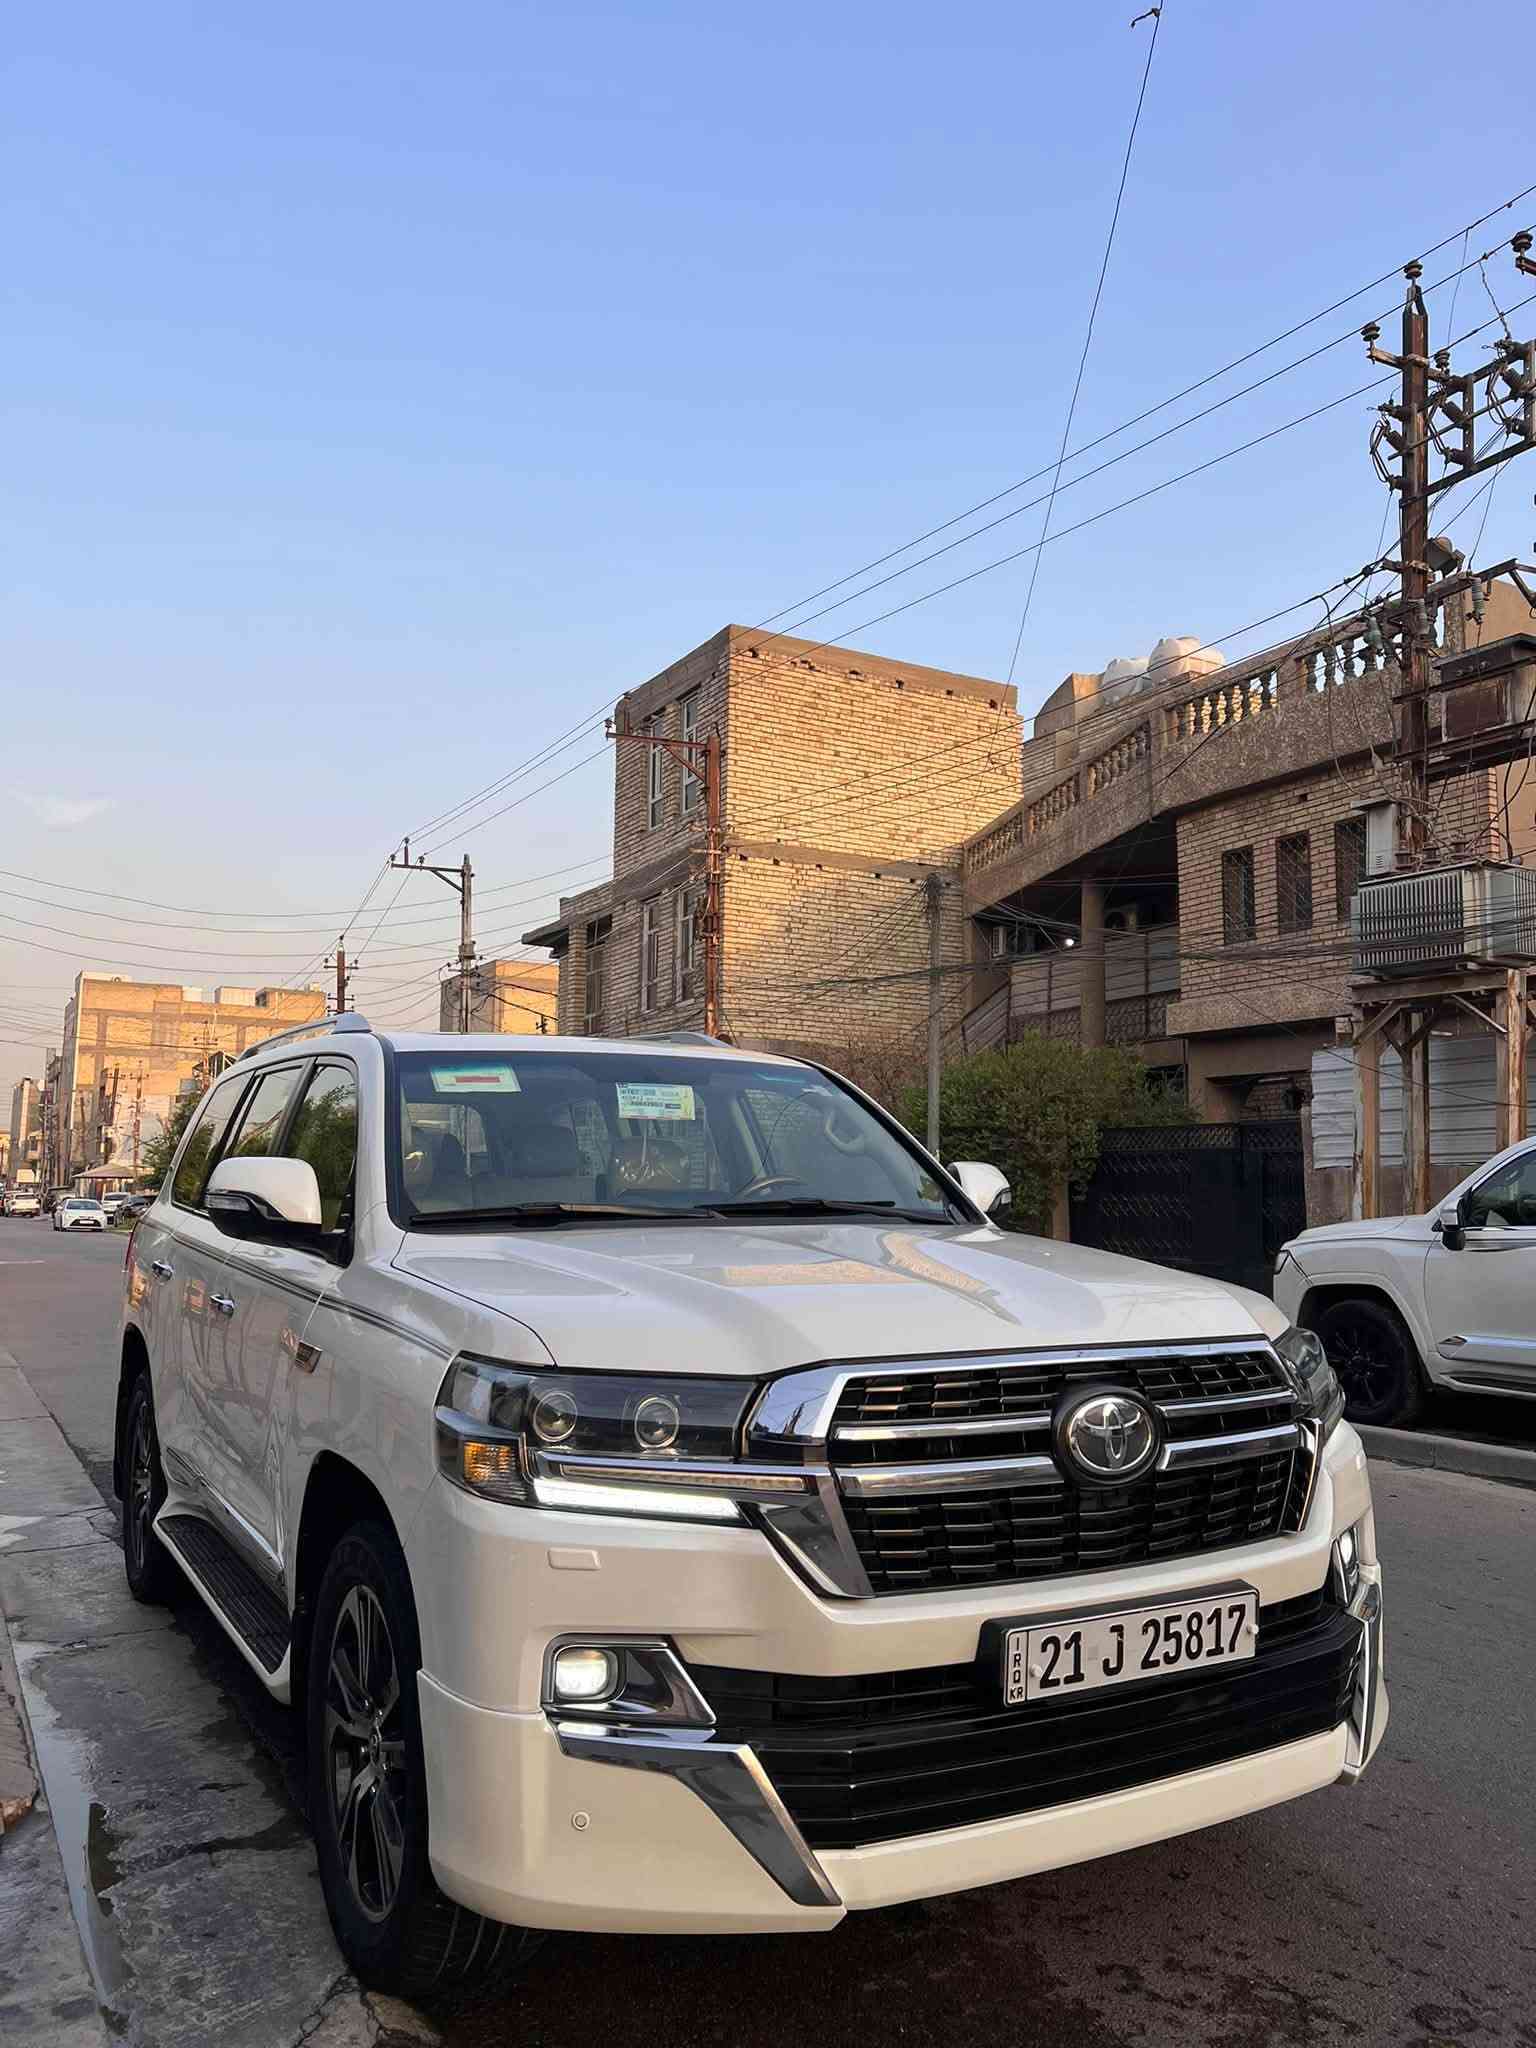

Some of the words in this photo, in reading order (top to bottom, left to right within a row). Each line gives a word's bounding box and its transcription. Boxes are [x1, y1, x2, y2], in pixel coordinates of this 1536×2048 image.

[1039, 1630, 1085, 1690] 21
[1102, 1624, 1125, 1677] J
[1140, 1603, 1247, 1670] 25817
